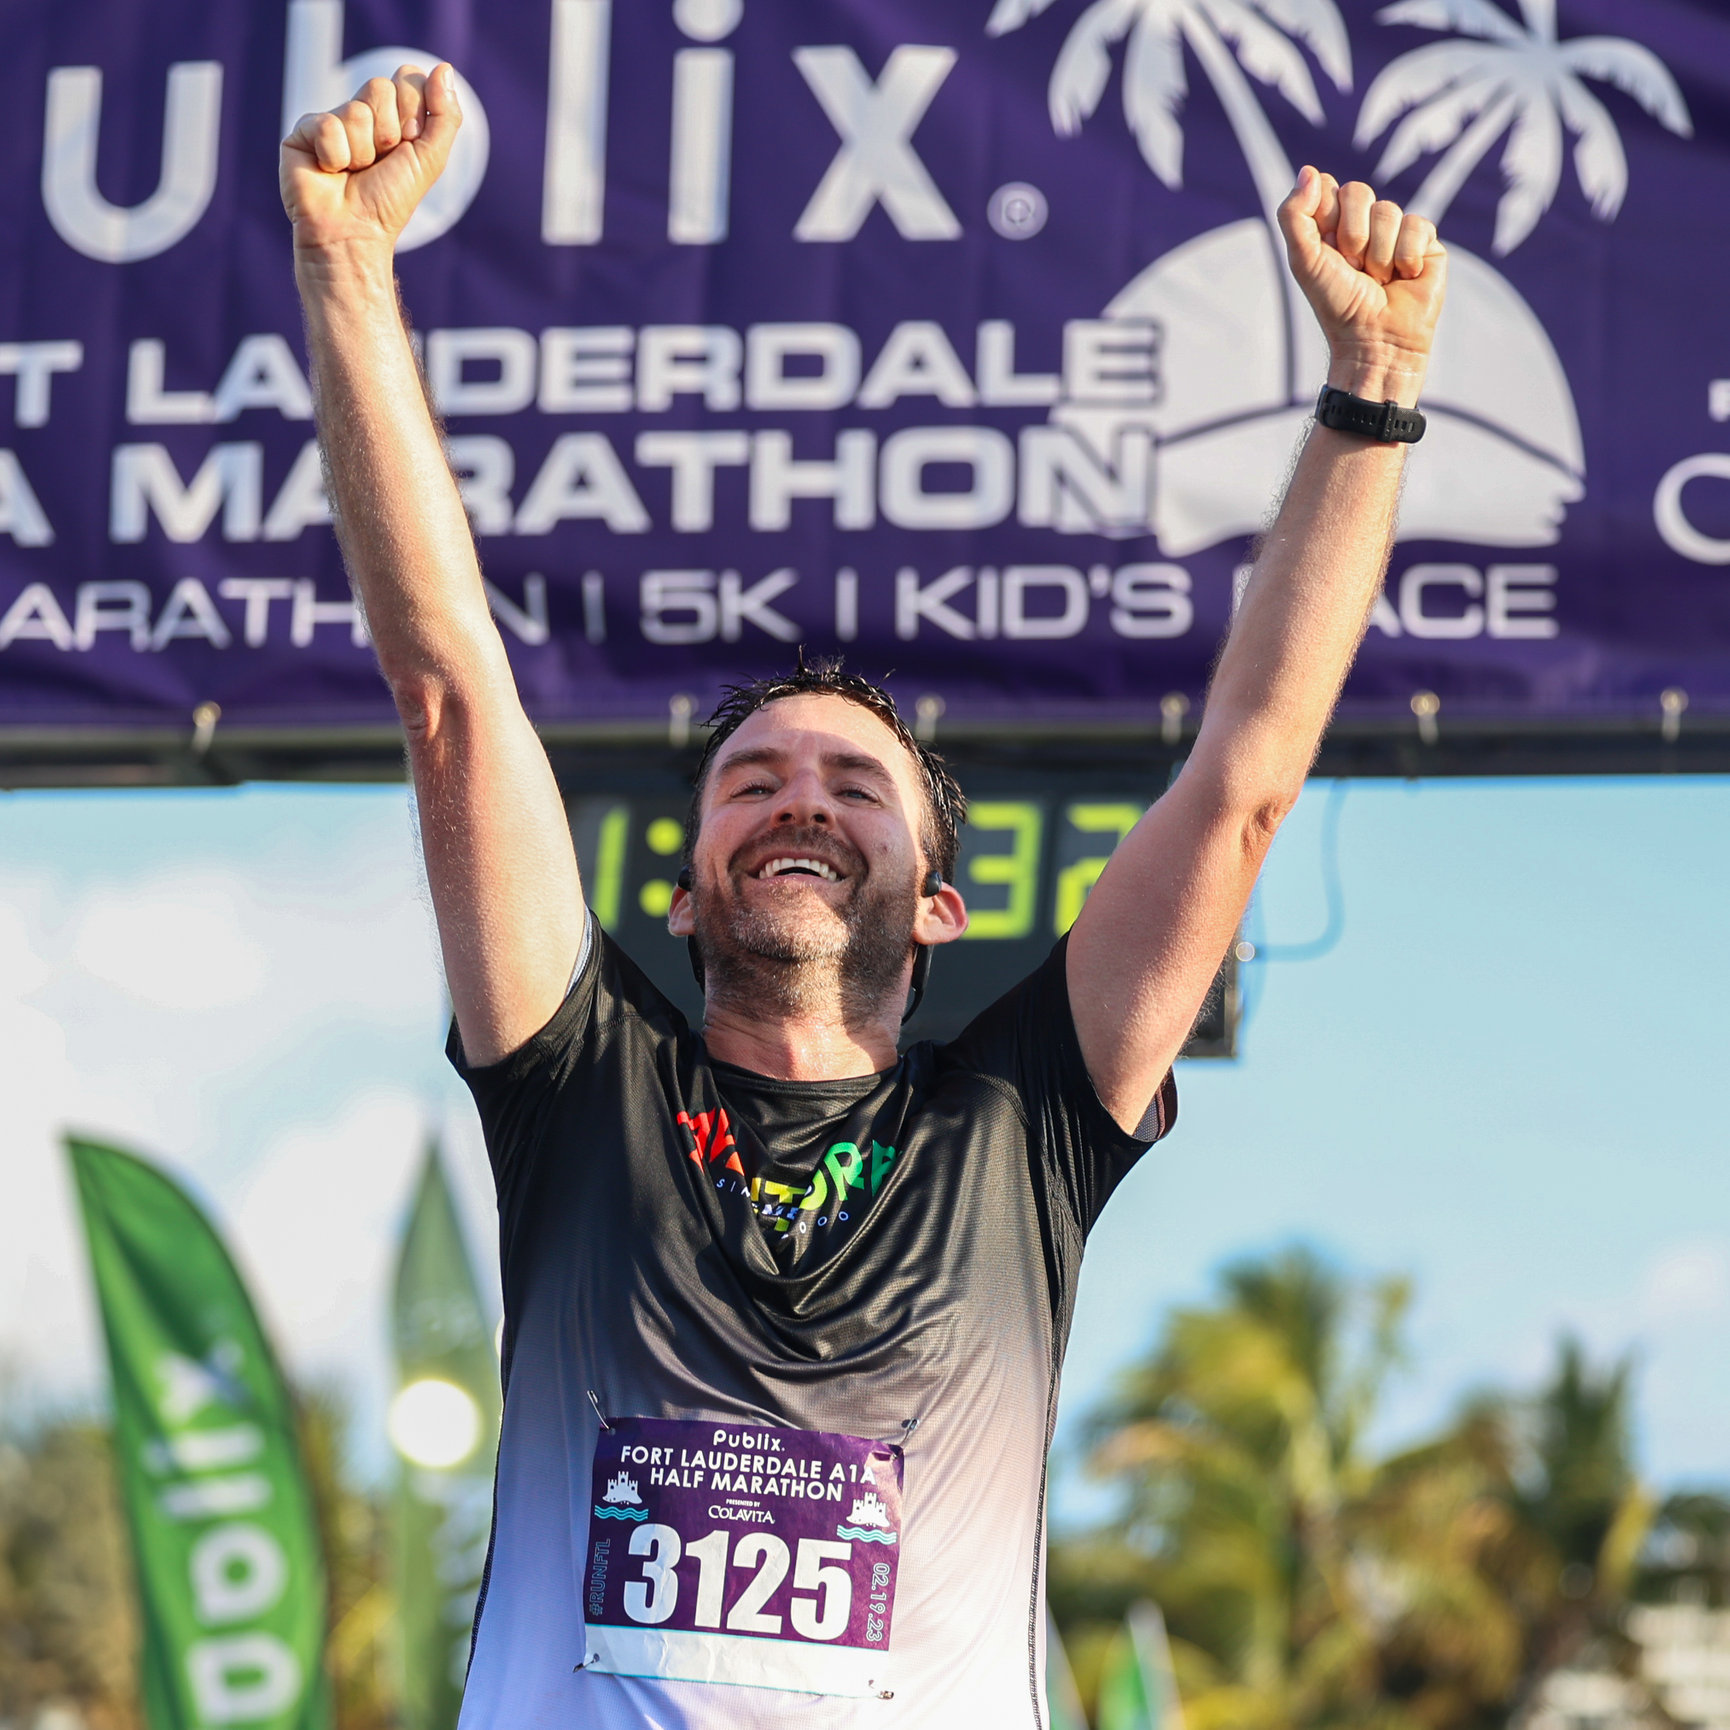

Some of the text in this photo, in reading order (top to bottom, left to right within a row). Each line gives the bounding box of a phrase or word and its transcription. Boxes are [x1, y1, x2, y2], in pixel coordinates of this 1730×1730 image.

[126, 318, 1162, 424] LADERDALE
[0, 572, 549, 653] ARATHN
[641, 569, 800, 645] 5K
[894, 564, 1194, 642] KID'S
[1232, 562, 1559, 640] CE
[621, 1445, 877, 1486] FORT LAUDERDALE A1A
[650, 1468, 843, 1502] HALF MARATHON
[725, 1498, 754, 1507] PRESENTED
[708, 1504, 776, 1525] COLAVITA
[589, 1537, 611, 1616] #RUNFTL
[623, 1523, 852, 1641] 3125
[866, 1562, 891, 1642] 02.19.23
